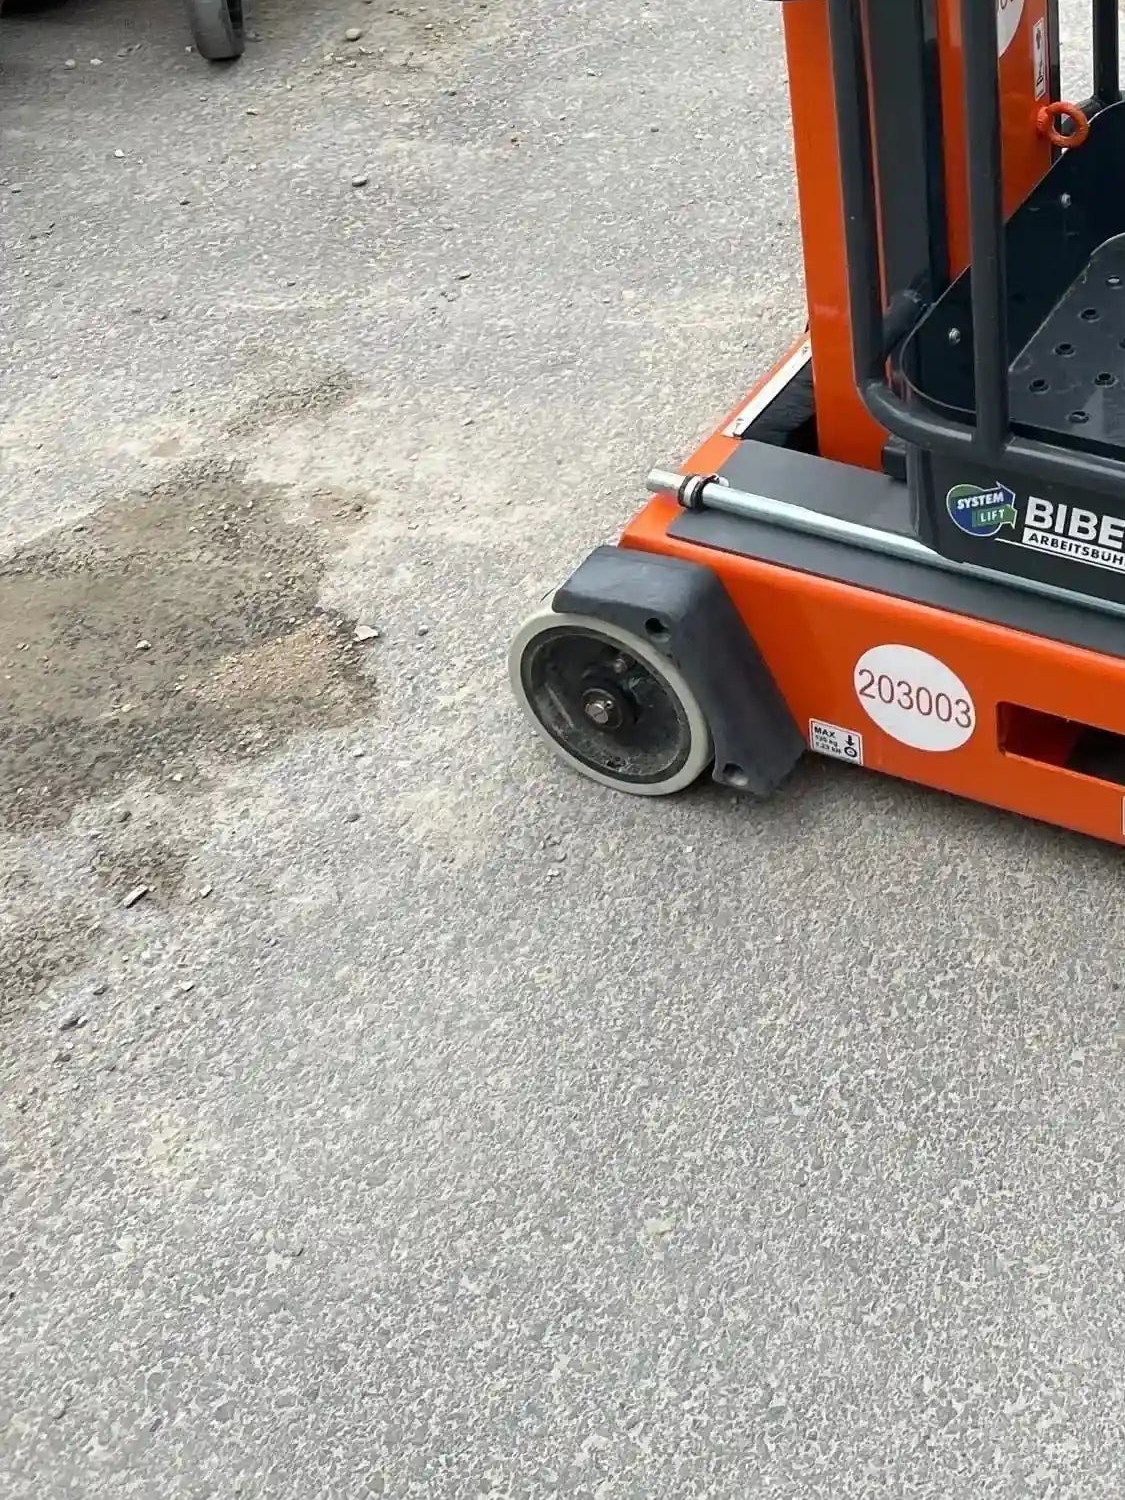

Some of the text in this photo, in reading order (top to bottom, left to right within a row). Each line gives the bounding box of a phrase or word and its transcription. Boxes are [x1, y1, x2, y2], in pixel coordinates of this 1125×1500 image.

[957, 491, 1004, 510] SYSTEM
[980, 509, 1005, 523] LIFT
[858, 668, 972, 729] 203003
[814, 726, 836, 738] MAX
